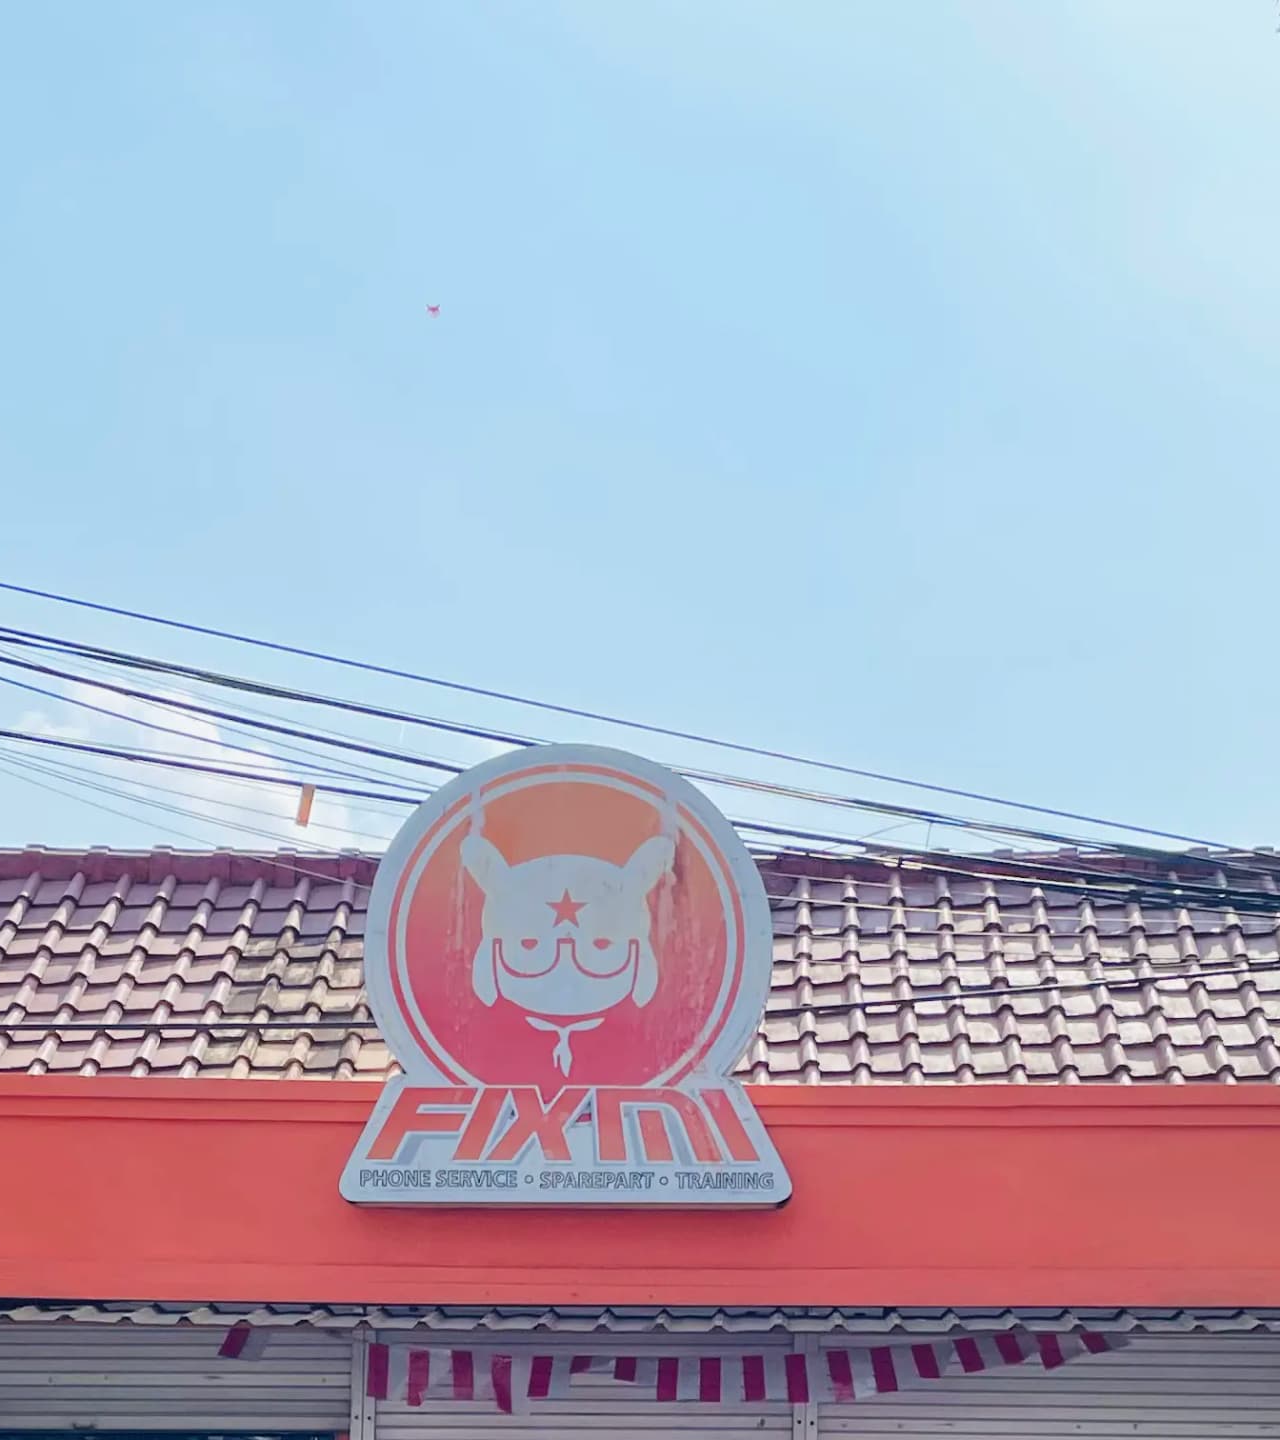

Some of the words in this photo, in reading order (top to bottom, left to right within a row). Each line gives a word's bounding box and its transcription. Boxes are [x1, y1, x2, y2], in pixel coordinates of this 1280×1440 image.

[364, 1085, 761, 1162] FIXMI
[359, 1169, 431, 1188] PHONE
[435, 1169, 518, 1189] SERVICE
[539, 1171, 655, 1190] SPAREPART
[675, 1171, 775, 1190] TRAINING
